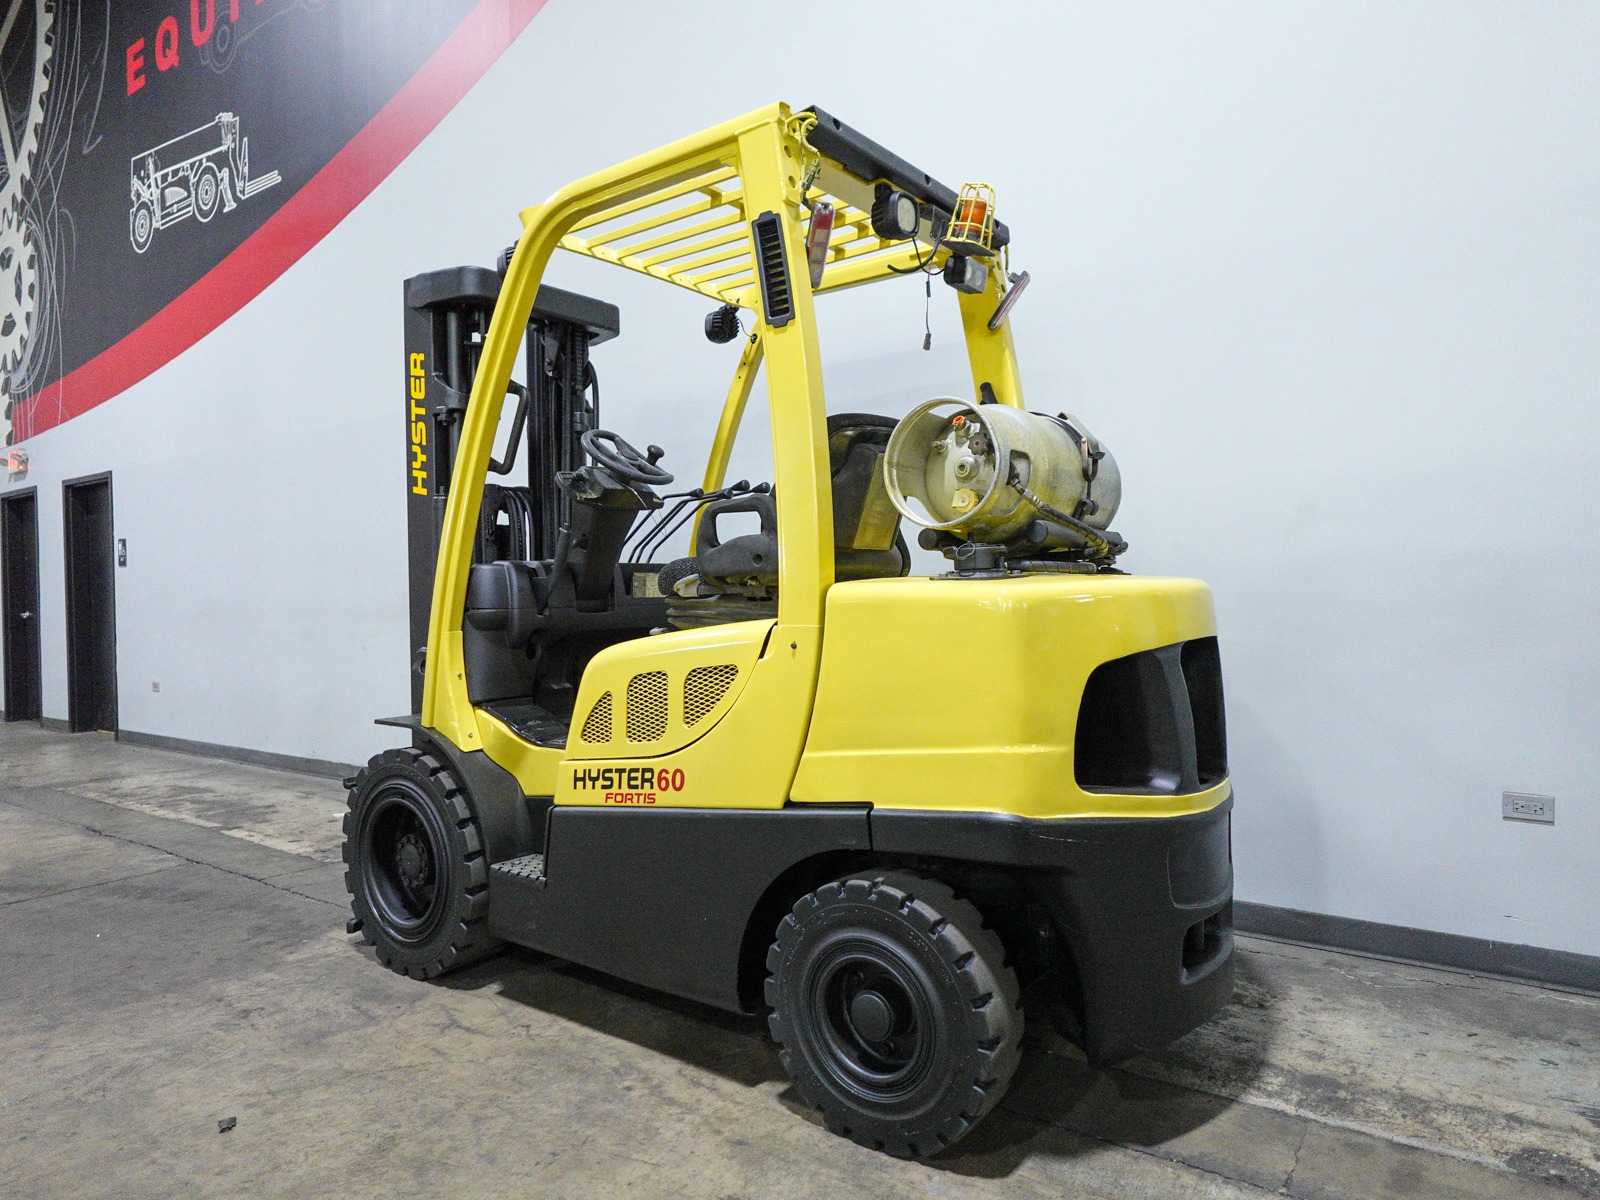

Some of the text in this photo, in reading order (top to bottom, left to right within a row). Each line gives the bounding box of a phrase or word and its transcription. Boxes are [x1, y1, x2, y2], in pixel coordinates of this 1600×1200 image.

[126, 0, 266, 96] EQU
[409, 352, 428, 497] HYSTER
[573, 767, 686, 792] HYSTER 60
[604, 792, 657, 805] FORTIS
